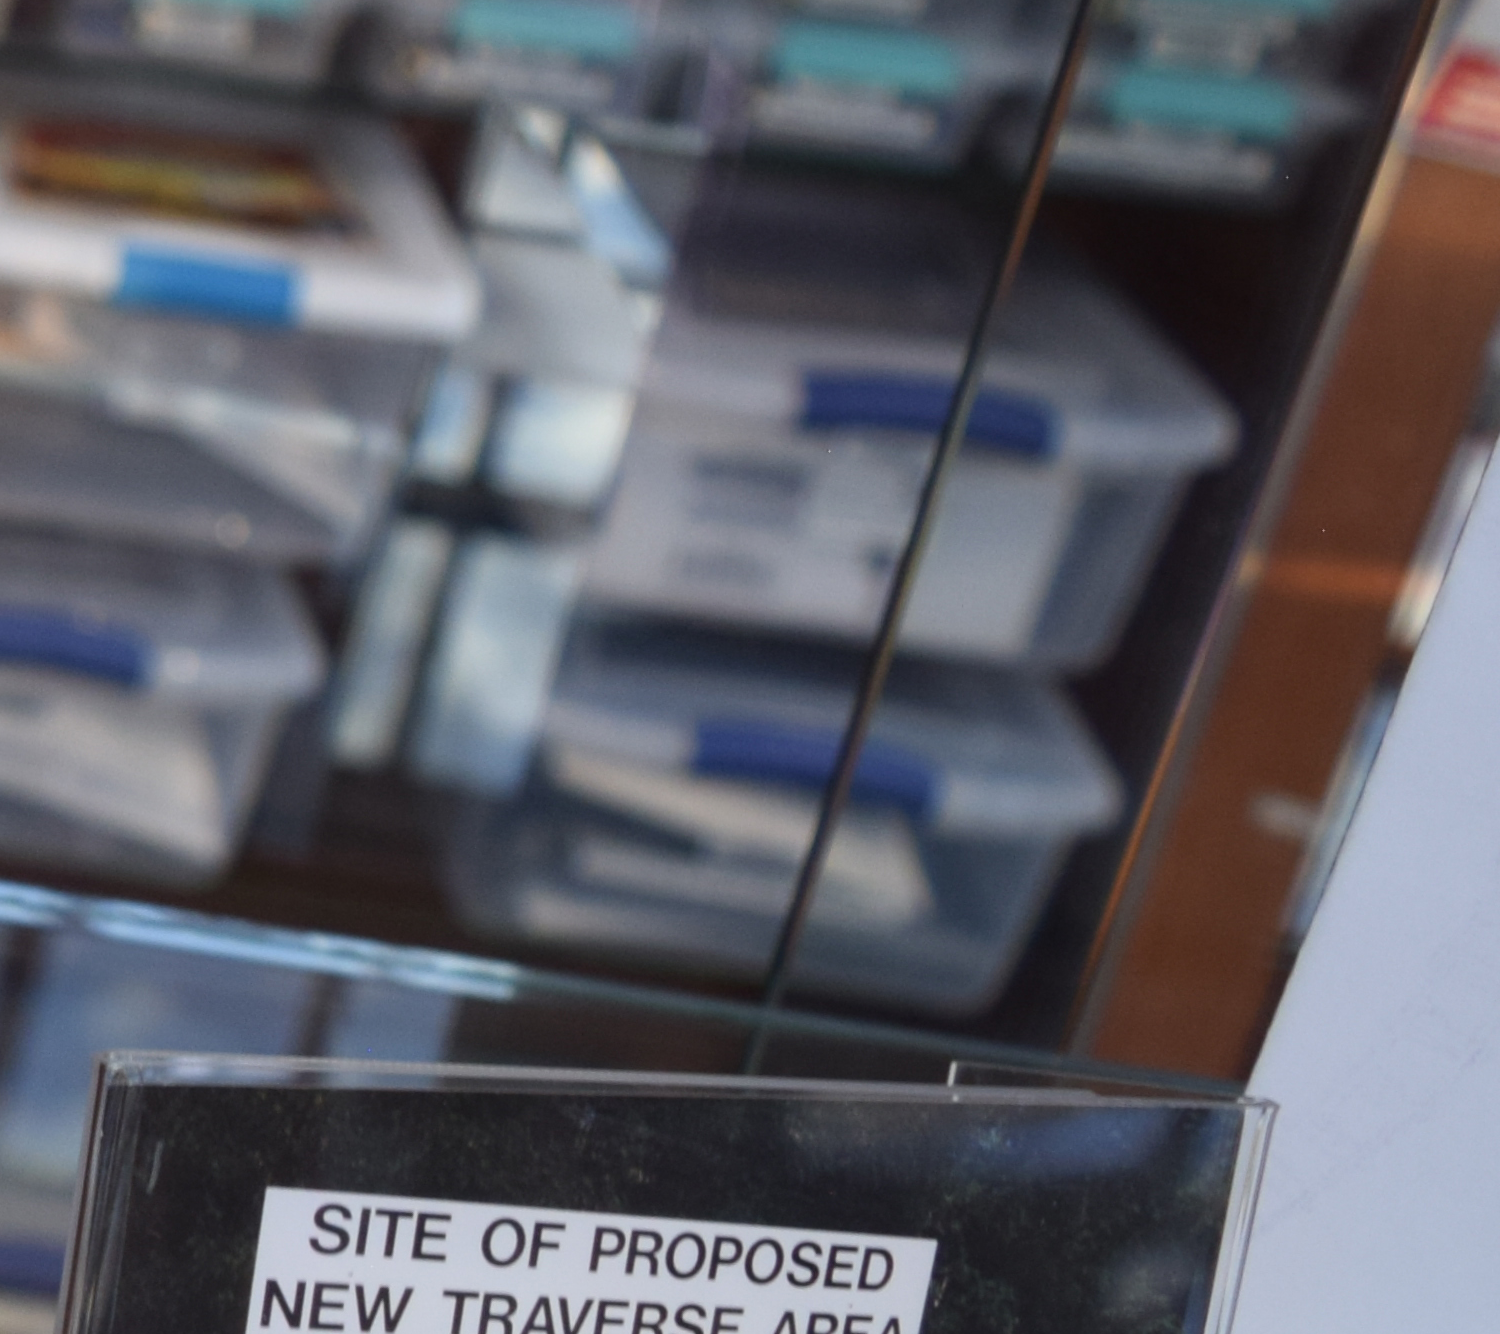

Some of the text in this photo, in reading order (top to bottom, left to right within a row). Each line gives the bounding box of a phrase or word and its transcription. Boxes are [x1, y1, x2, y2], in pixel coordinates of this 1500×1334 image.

[308, 1204, 896, 1292] SITE OF PROPOSED
[259, 1279, 414, 1333] NEW
